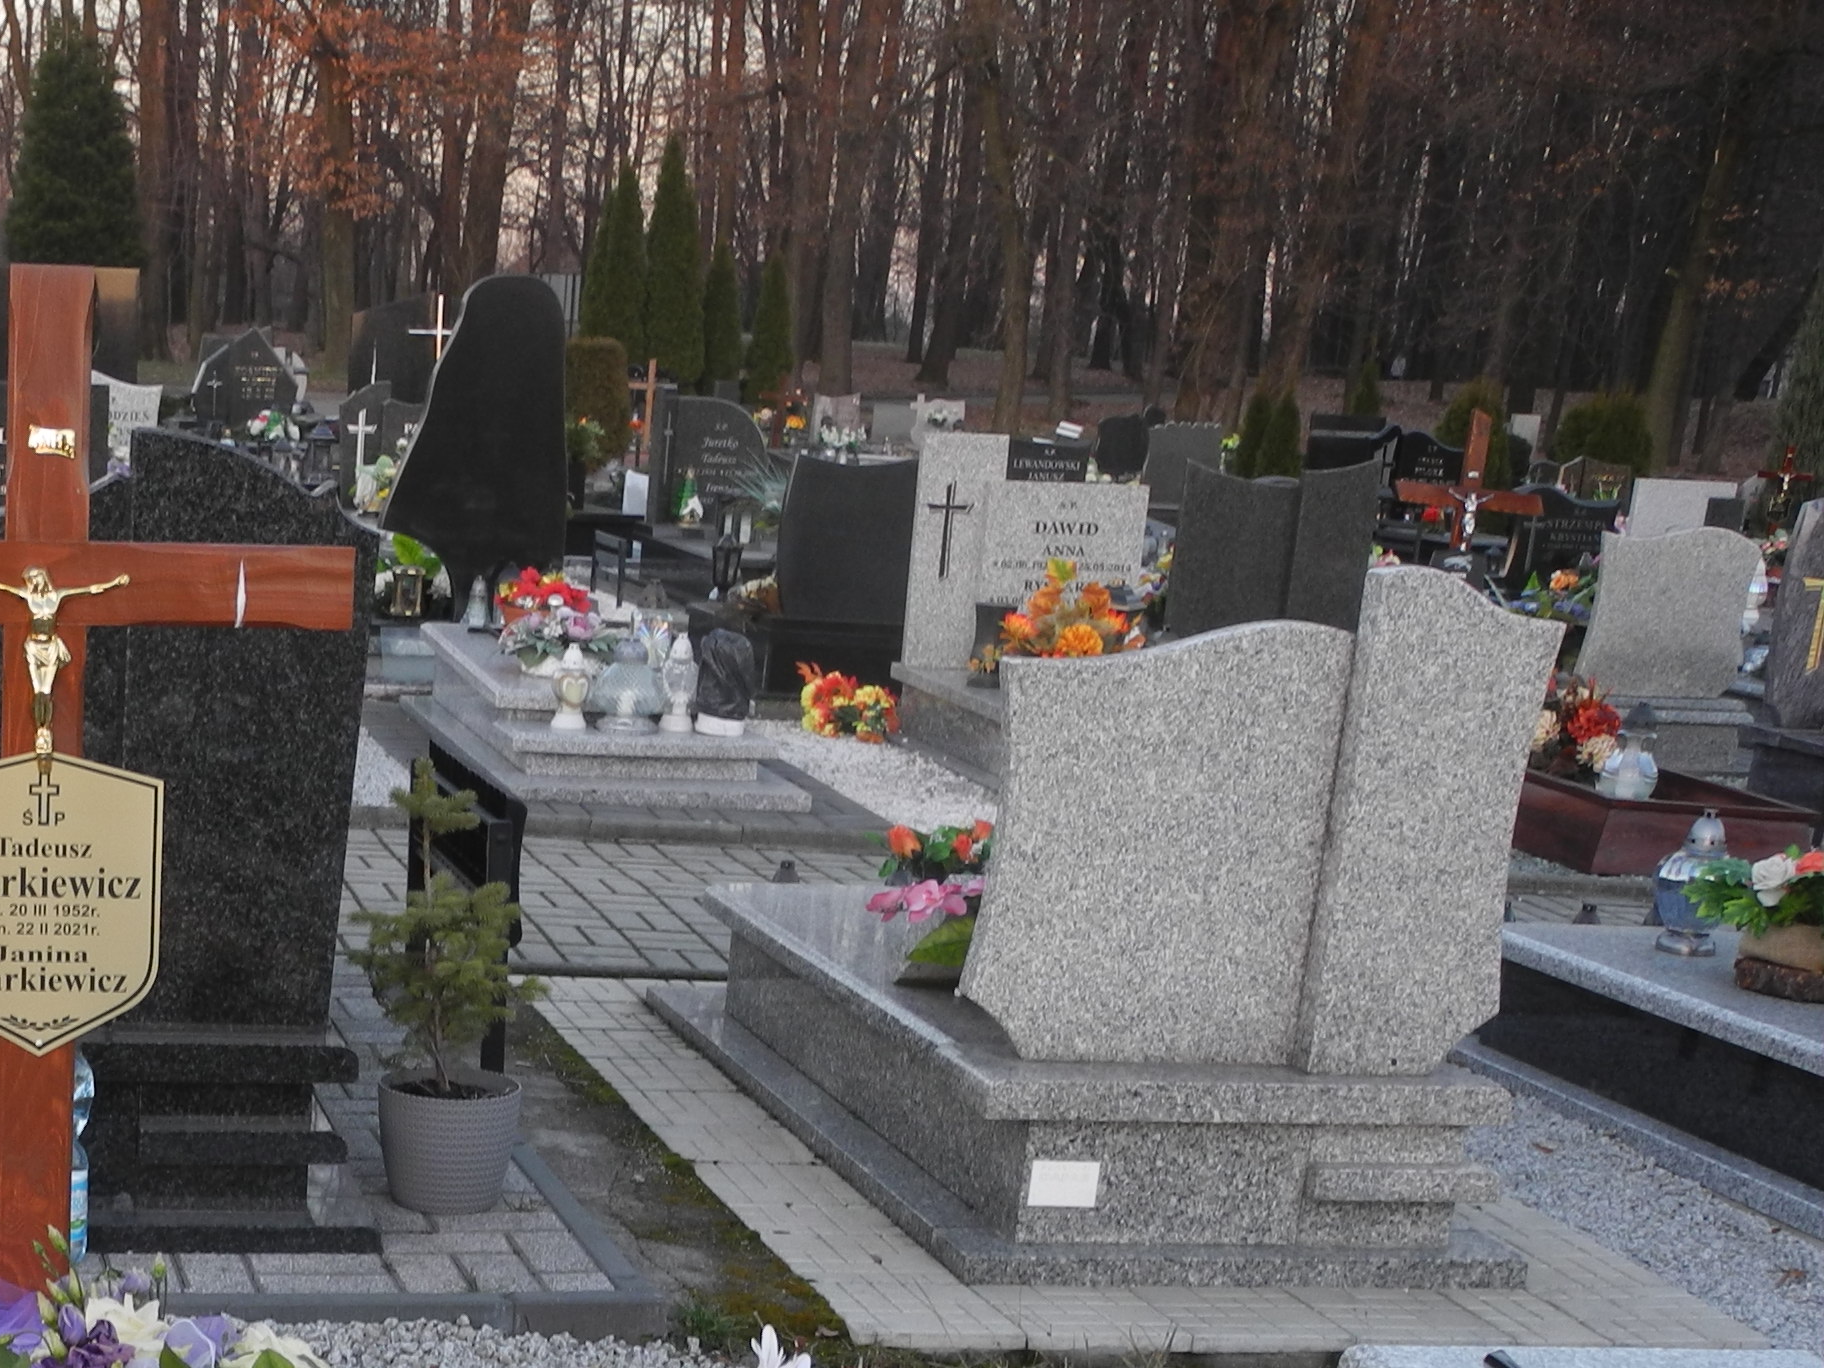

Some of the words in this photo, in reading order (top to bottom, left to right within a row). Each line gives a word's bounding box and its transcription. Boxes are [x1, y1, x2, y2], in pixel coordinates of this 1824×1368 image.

[1013, 458, 1081, 471] LEWANDOWSKI
[1035, 521, 1099, 536] DAWID
[1043, 545, 1085, 557] ANNA
[9, 904, 27, 917] 20
[33, 905, 48, 917] III
[53, 904, 101, 918] 1952r.
[16, 923, 34, 935] 22
[39, 923, 49, 935] II
[53, 922, 101, 936] 2021r.
